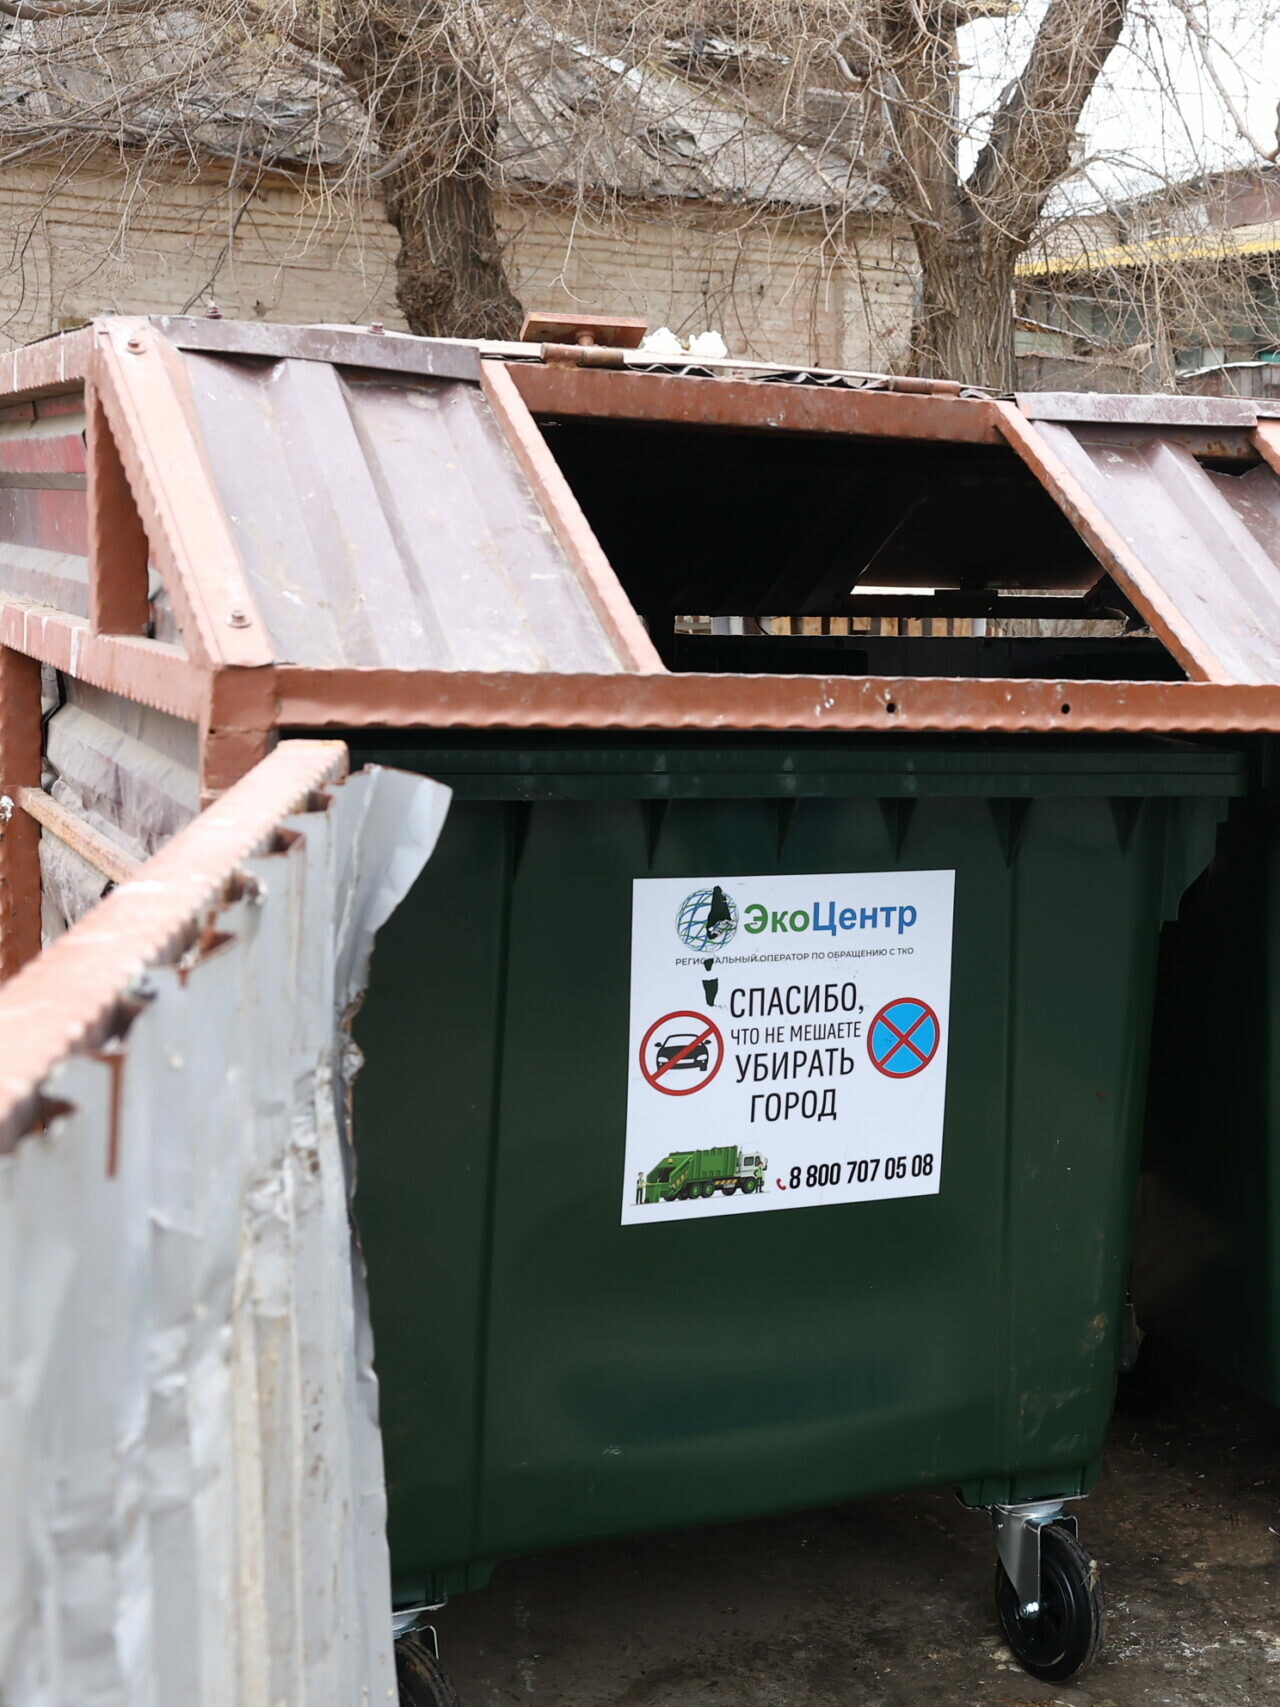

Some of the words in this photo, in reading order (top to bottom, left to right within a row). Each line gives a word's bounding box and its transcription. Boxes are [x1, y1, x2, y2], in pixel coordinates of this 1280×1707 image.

[743, 901, 917, 936] ЭкоЦентр
[675, 954, 757, 966] РЕГИОАЛЬНЫЙ
[759, 952, 809, 963] ОПЕРАТОР
[811, 952, 825, 960] ПО
[827, 948, 887, 960] ОБРАЩЕНИЮ
[889, 948, 895, 956] С
[897, 947, 914, 955] ТКО
[730, 982, 864, 1018] СПАСИБО,
[731, 1027, 759, 1045] ЧТО
[765, 1025, 784, 1043] НЕ
[790, 1021, 861, 1041] МЕШАЕТЕ
[736, 1048, 855, 1083] УБИРАТЬ
[750, 1089, 837, 1123] ГОРОД
[789, 1166, 801, 1188] 8
[806, 1162, 841, 1187] 800
[847, 1159, 880, 1184] 707
[884, 1155, 906, 1180] 05
[911, 1153, 934, 1177] 08
